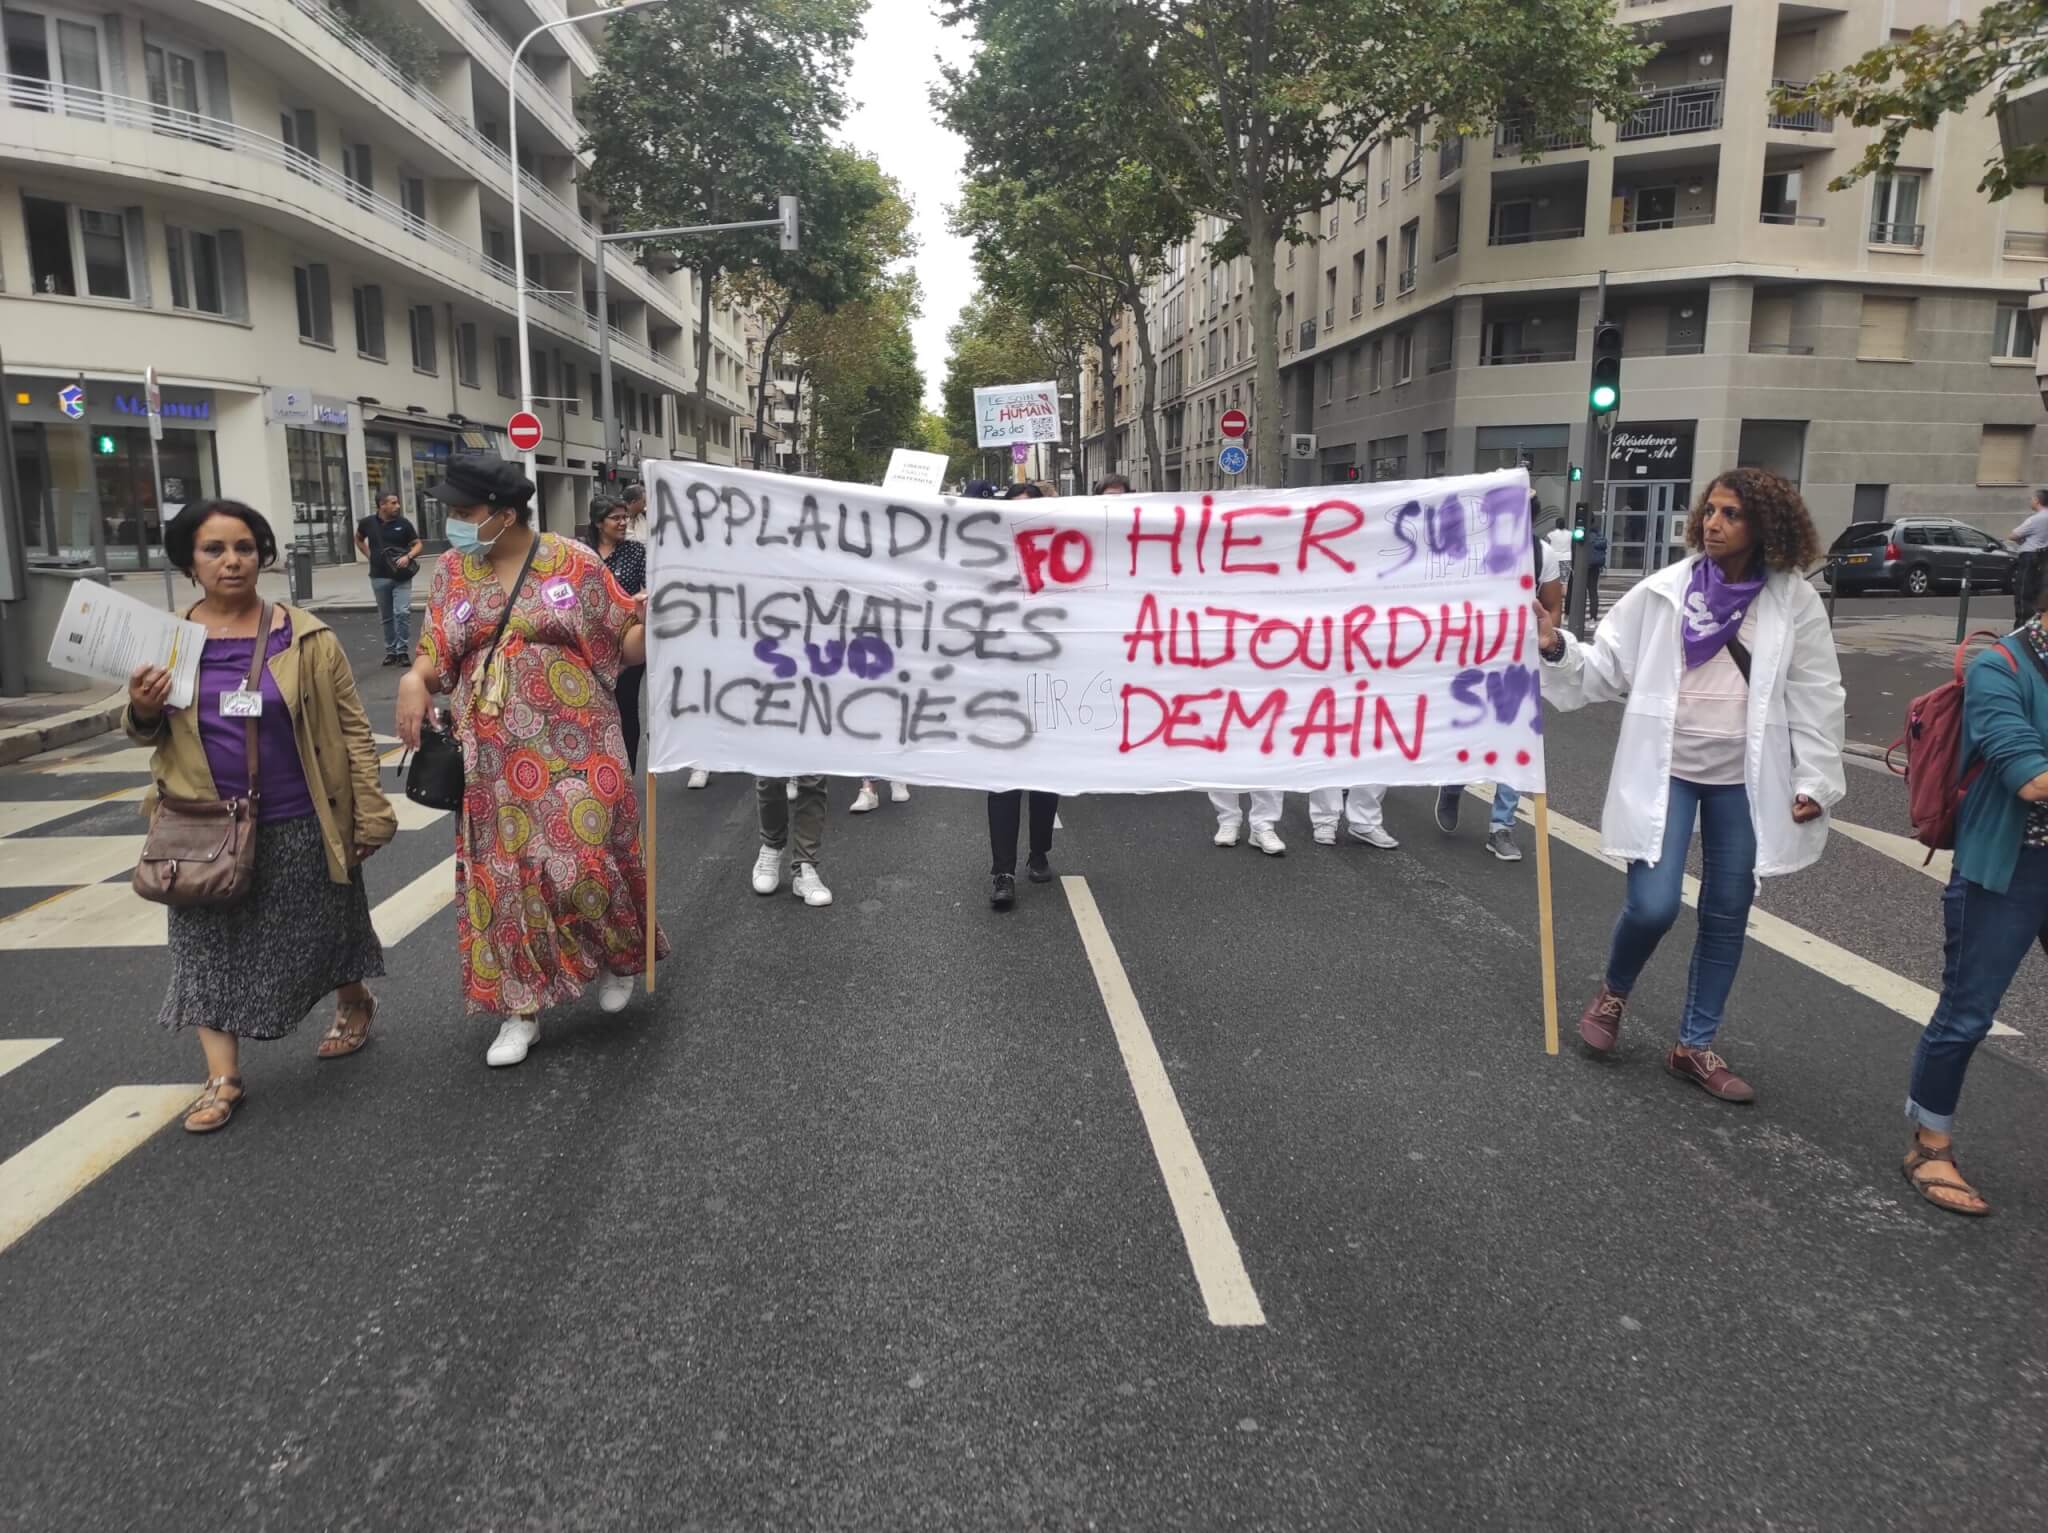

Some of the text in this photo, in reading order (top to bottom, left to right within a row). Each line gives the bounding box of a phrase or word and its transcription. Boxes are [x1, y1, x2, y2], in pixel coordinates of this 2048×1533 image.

[1000, 402, 1053, 423] HUMAIN
[983, 420, 1025, 439] Pas des
[1612, 433, 1677, 447] Résidence
[1648, 446, 1678, 459] Art
[1014, 526, 1095, 595] FO
[753, 636, 896, 681] SUD
